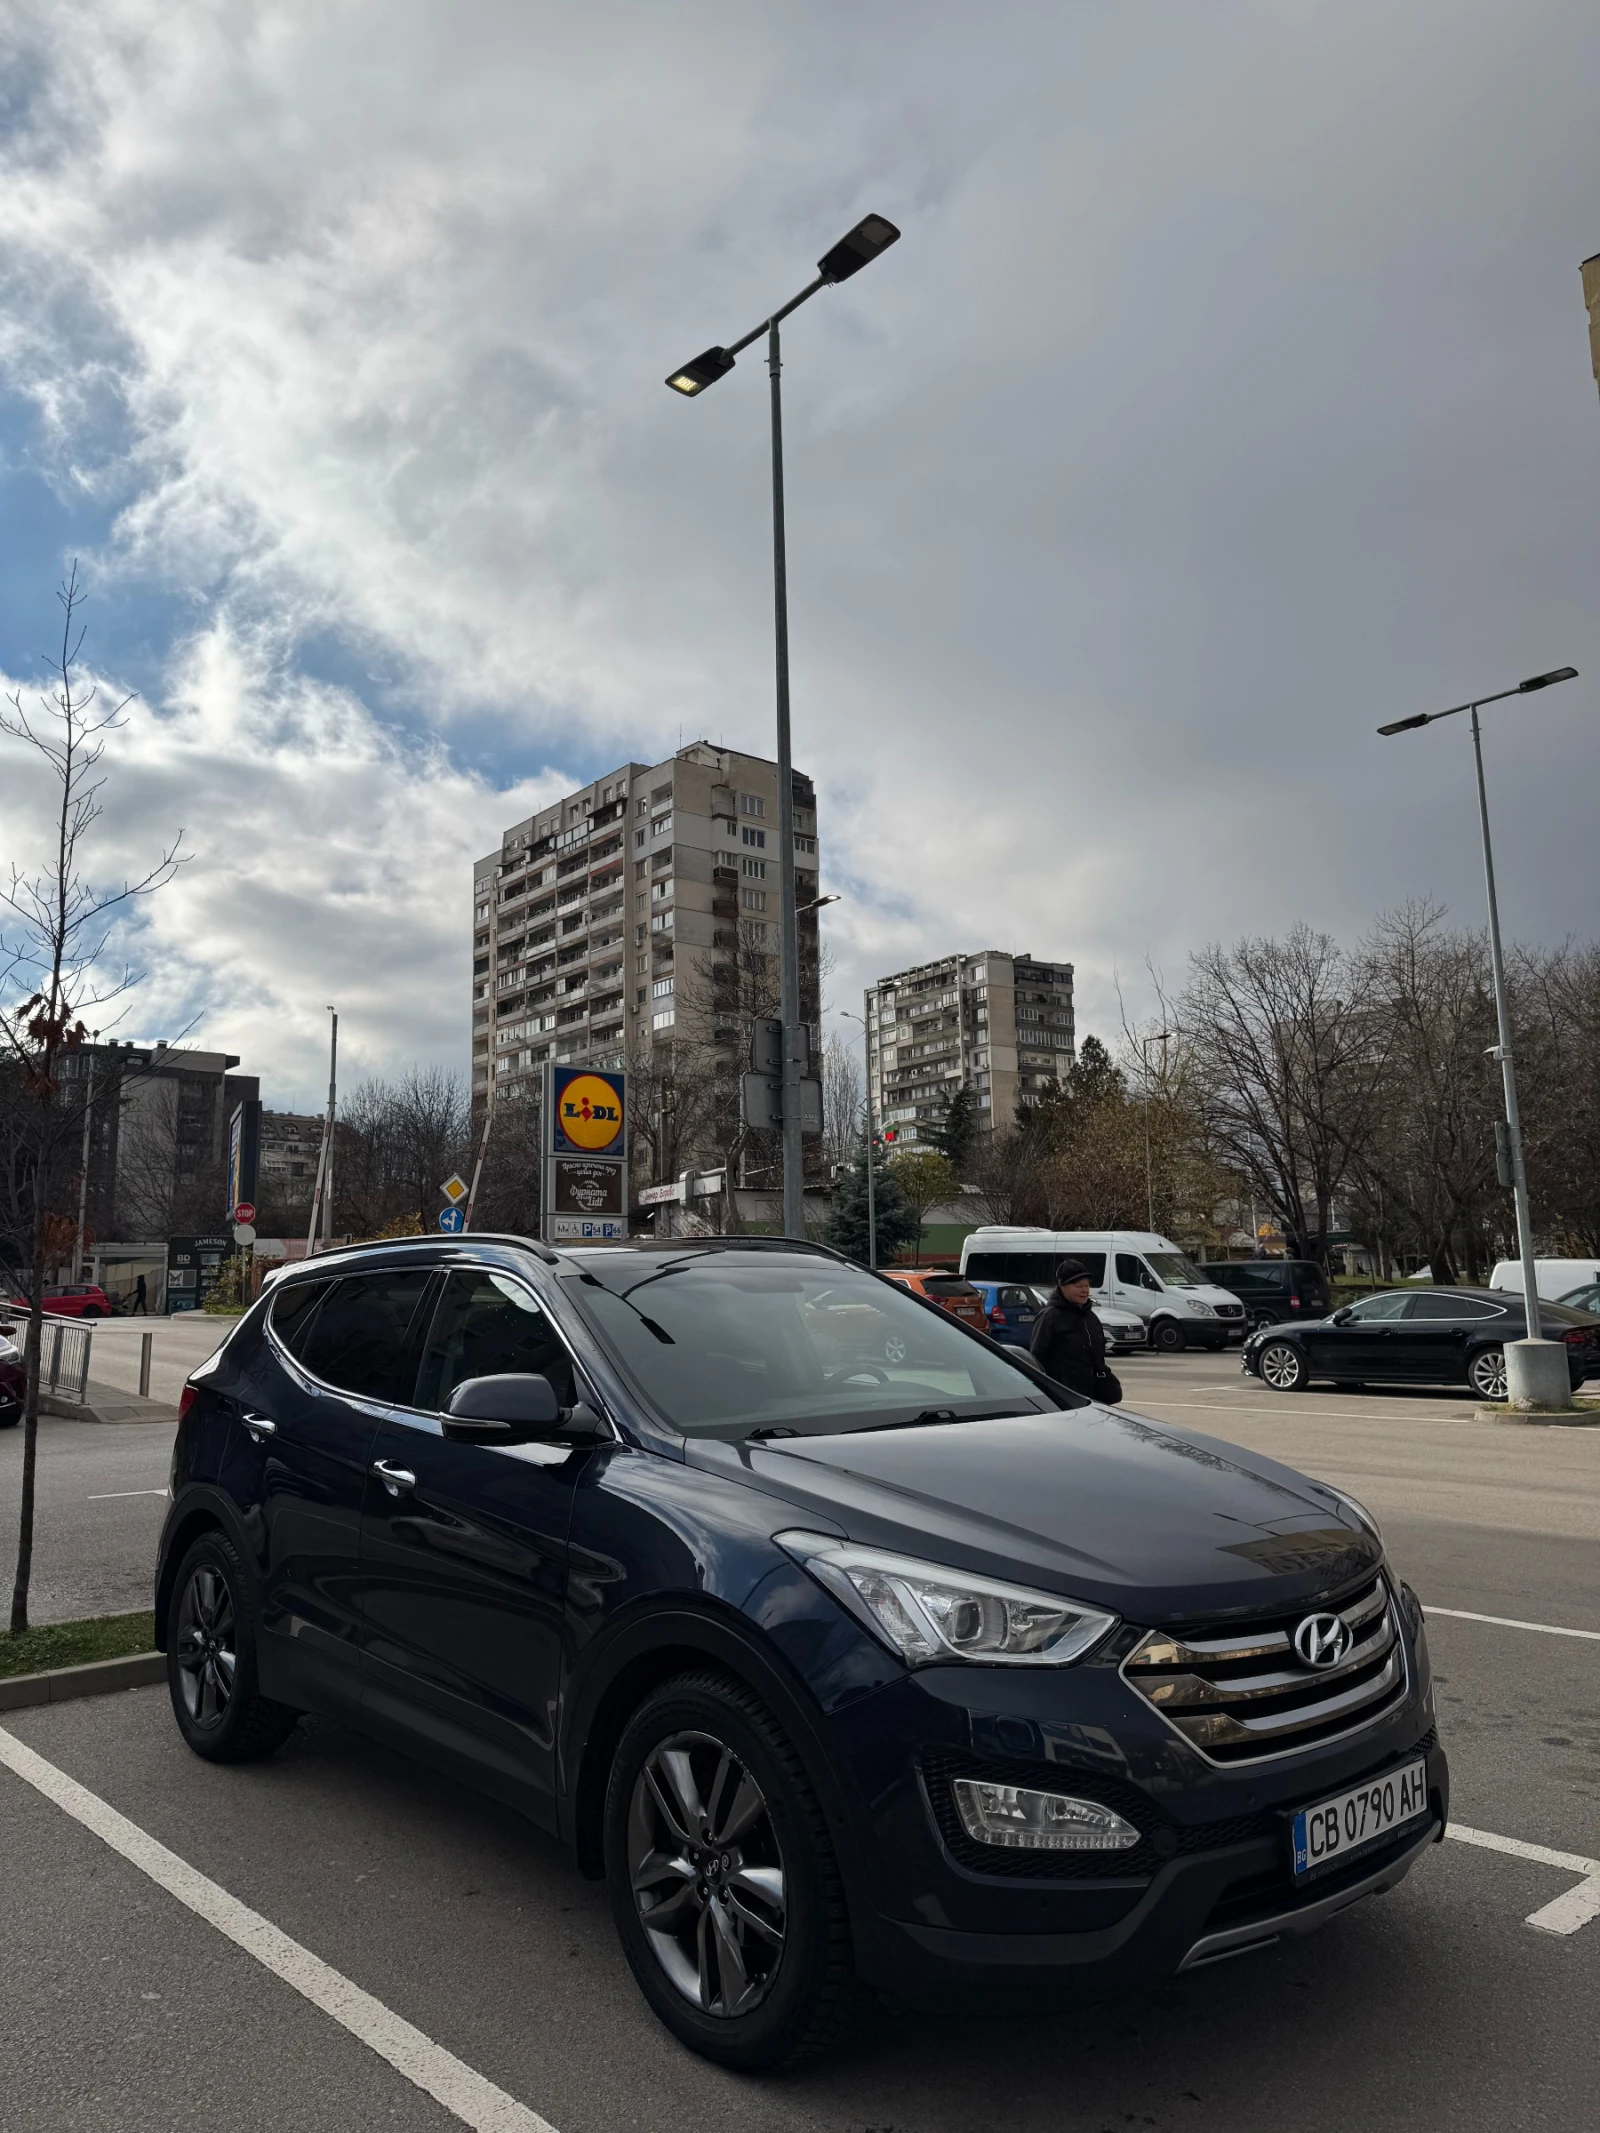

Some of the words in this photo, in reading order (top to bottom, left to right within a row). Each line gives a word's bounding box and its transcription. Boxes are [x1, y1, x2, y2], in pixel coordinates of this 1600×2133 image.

[569, 1184, 608, 1200] Фурната
[587, 1197, 604, 1207] Lidl
[236, 1209, 254, 1218] STOP
[194, 1238, 228, 1247] JAMESON
[1310, 1807, 1339, 1857] CB
[1345, 1782, 1394, 1841] 0790
[1400, 1767, 1424, 1817] AH
[1297, 1848, 1307, 1864] BG
